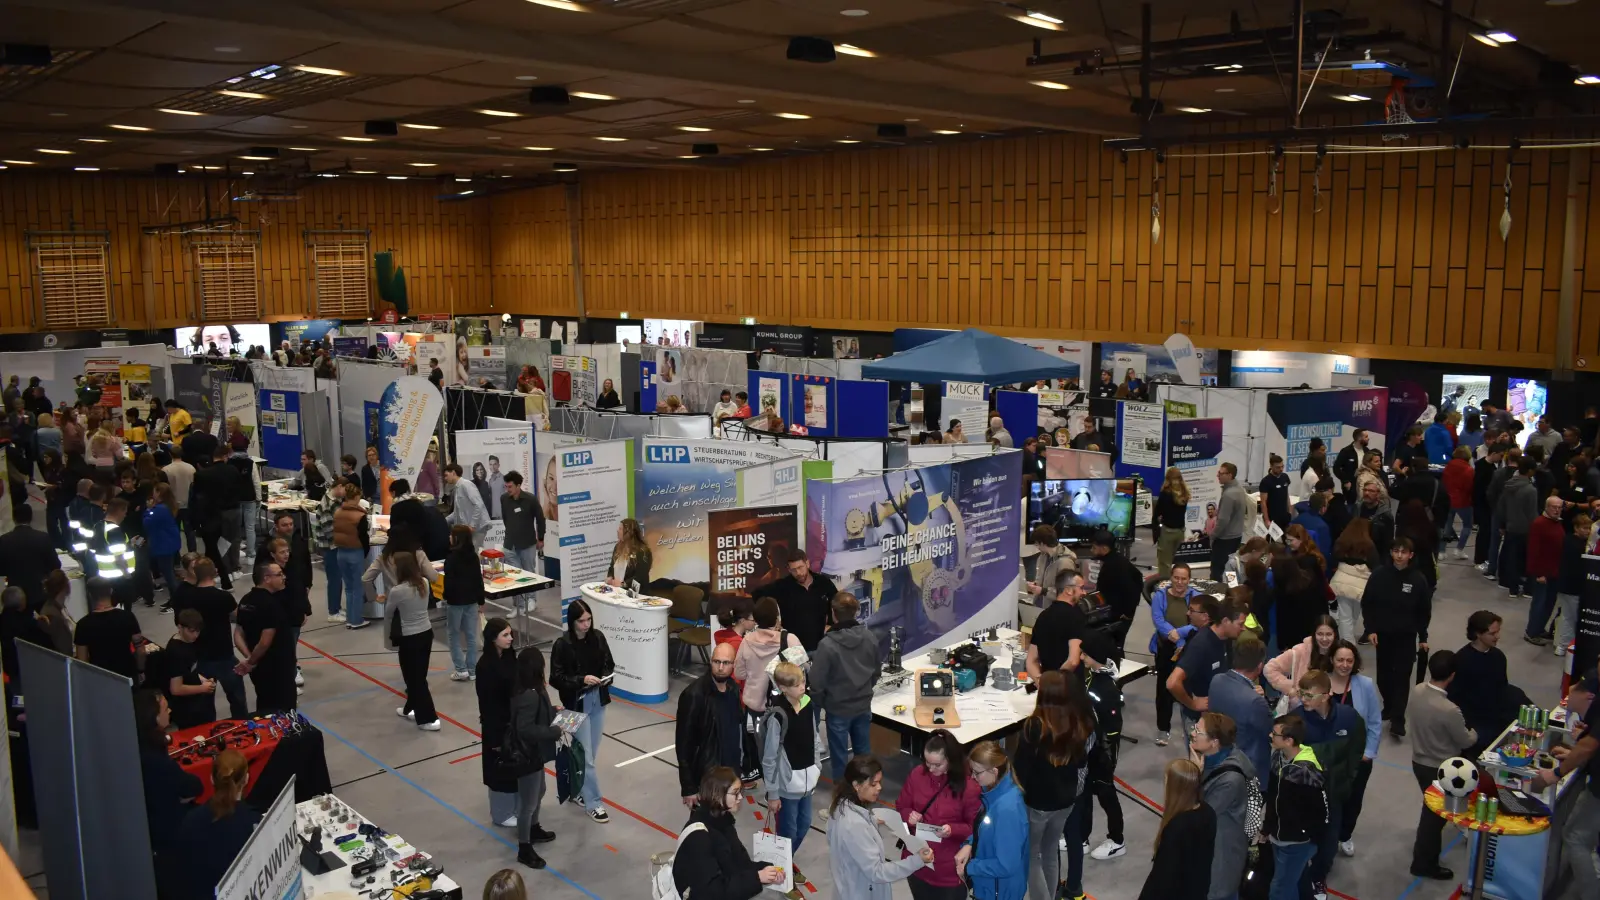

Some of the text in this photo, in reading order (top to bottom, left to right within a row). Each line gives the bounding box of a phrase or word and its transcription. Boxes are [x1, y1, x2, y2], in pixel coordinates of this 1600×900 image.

[949, 382, 981, 396] MUCK
[1352, 400, 1373, 412] HWS
[394, 398, 418, 445] Ausbildung
[400, 393, 429, 458] Duales Studium
[1290, 423, 1340, 438] IT CONSULTING
[650, 446, 686, 462] LHP
[694, 447, 747, 457] STEUERBERATUNG
[1180, 451, 1200, 459] Game?
[1289, 442, 1298, 455] IT
[565, 452, 590, 466] LHP
[973, 478, 982, 487] Wir
[998, 474, 1007, 482] aus
[650, 497, 680, 512] auch
[676, 513, 704, 529] wir
[656, 533, 704, 549] begleiten
[717, 532, 766, 549] BEI UNS
[881, 522, 957, 553] DEINE CHANCE
[881, 541, 953, 571] BEI HEUNISCH
[717, 562, 755, 577] HEISS
[717, 576, 747, 591] HER!
[619, 615, 635, 624] Viele
[628, 634, 656, 643] Partner
